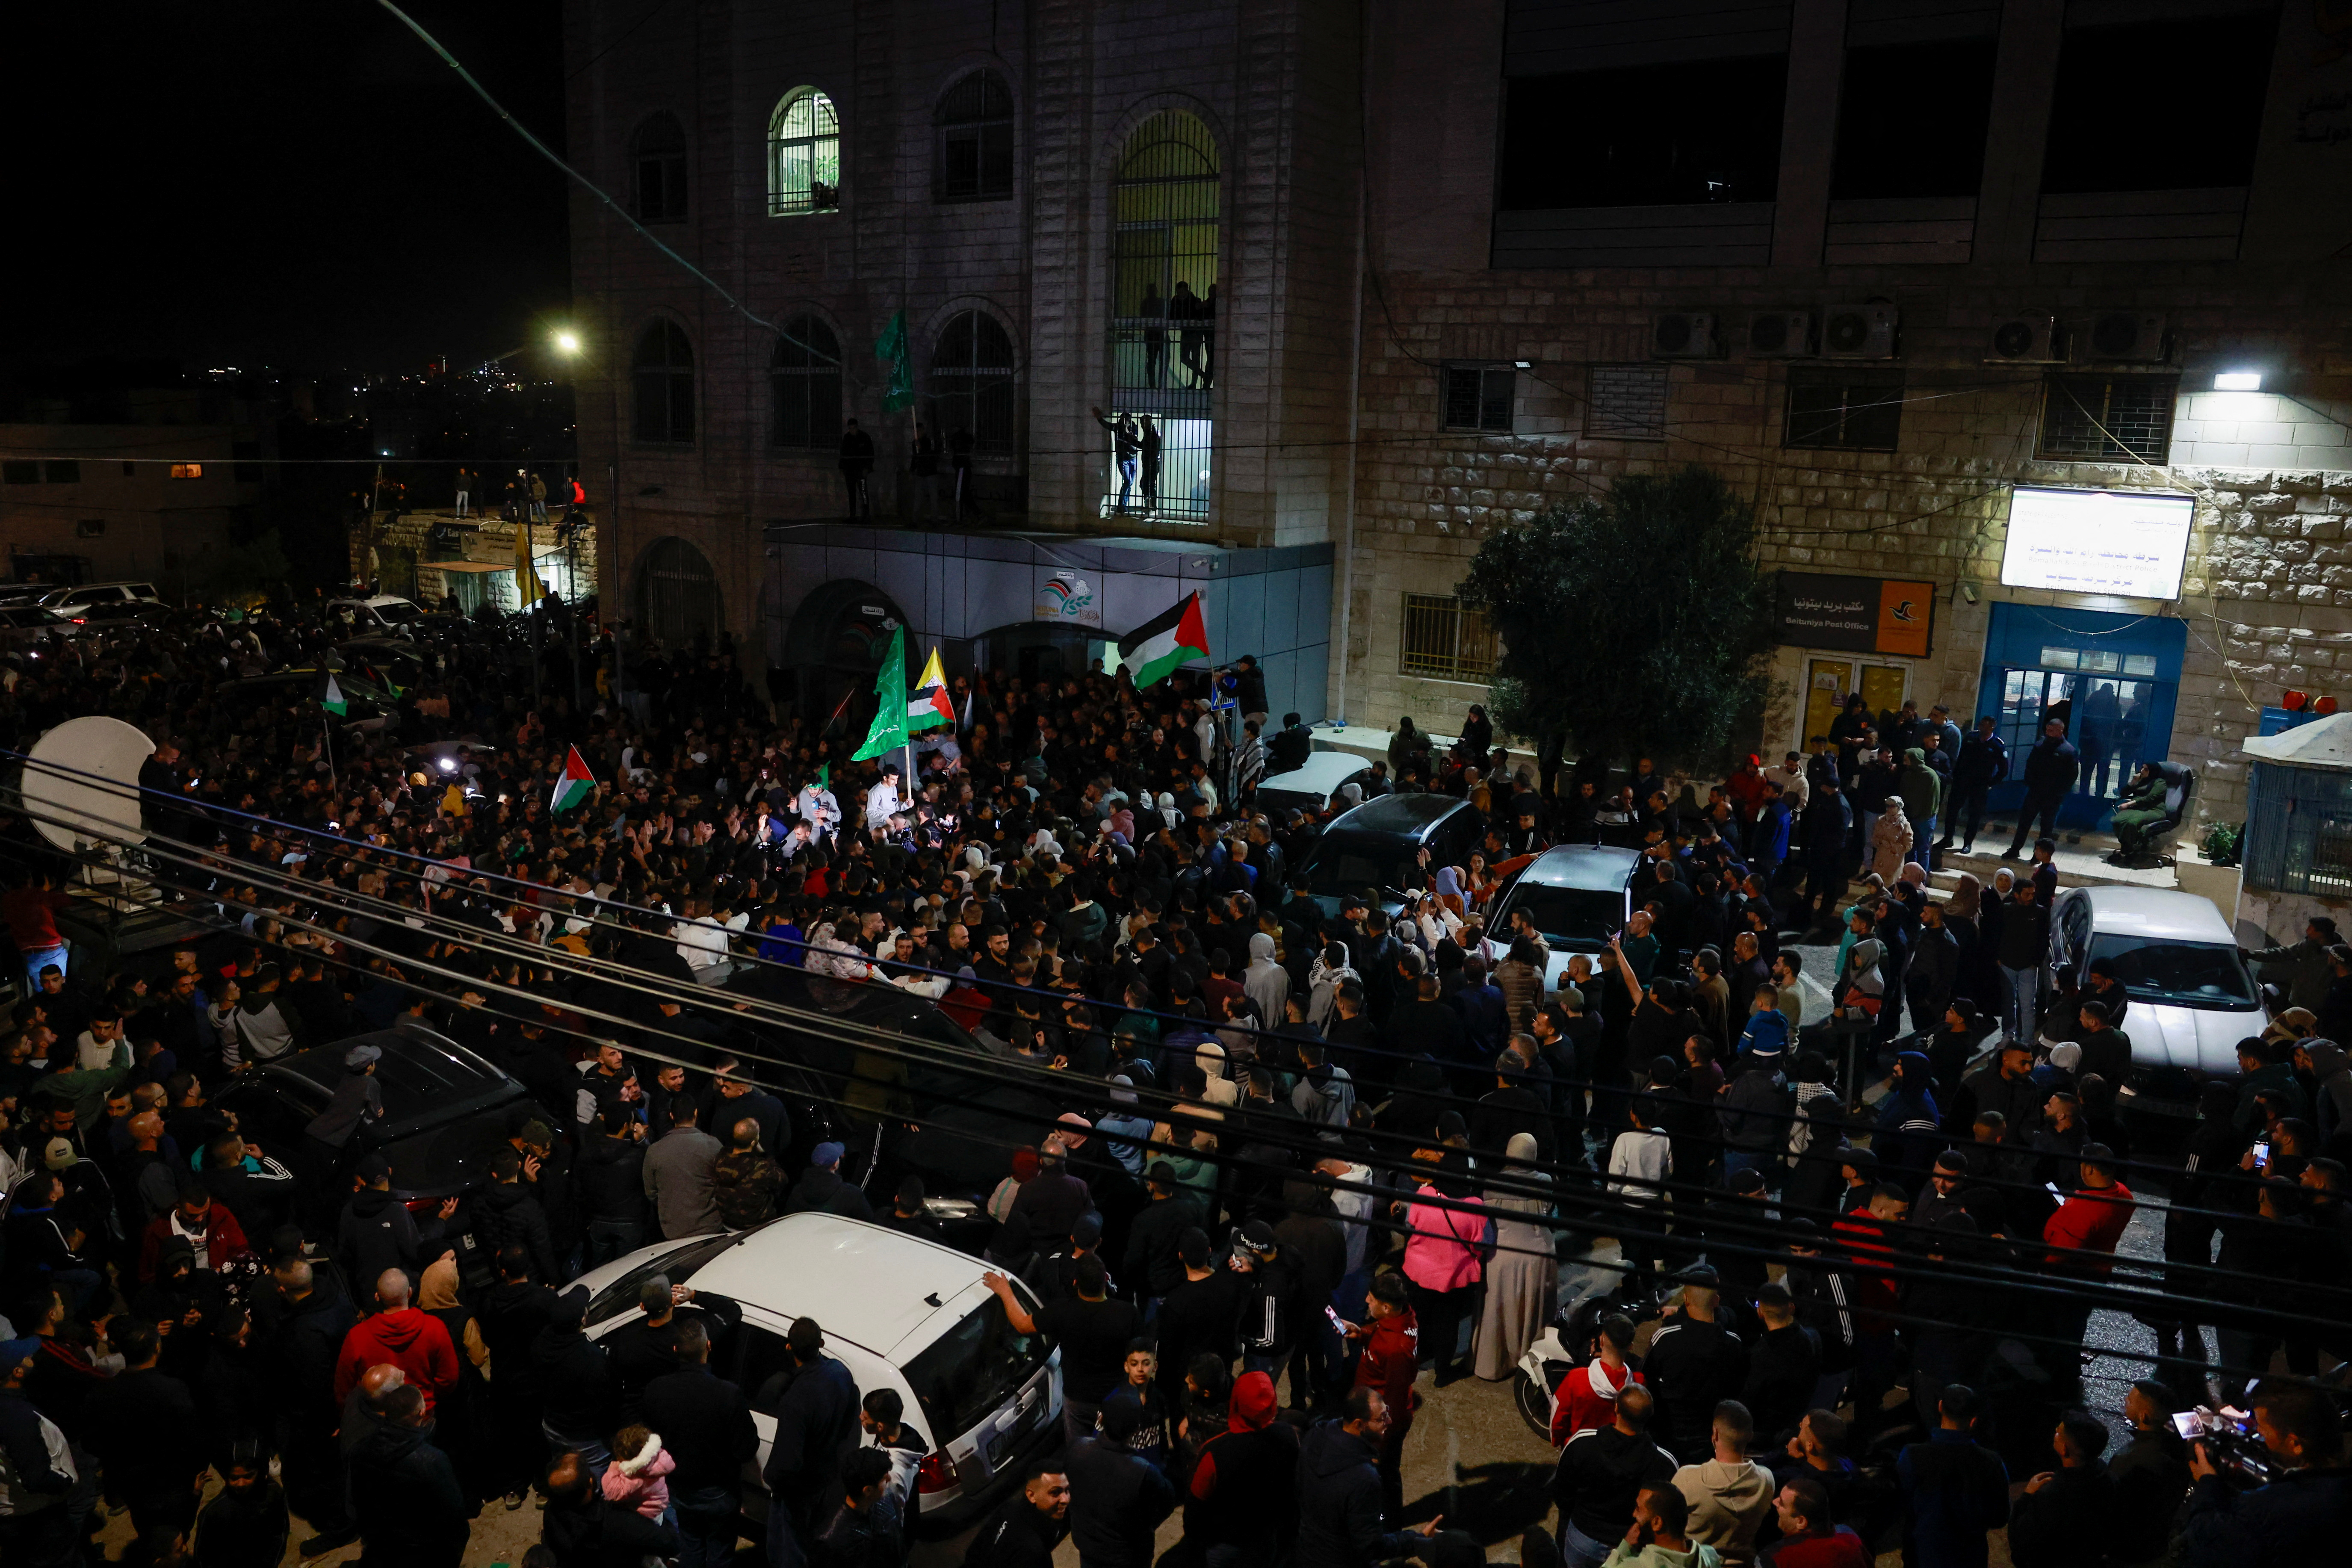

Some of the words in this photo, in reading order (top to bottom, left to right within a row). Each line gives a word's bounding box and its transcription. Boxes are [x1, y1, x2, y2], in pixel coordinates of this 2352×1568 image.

[2029, 556, 2063, 565] Ramallah
[2104, 562, 2133, 570] District
[2135, 564, 2158, 573] Police
[2110, 576, 2133, 587] مركز
[1794, 597, 1822, 611] بيتونيا
[1823, 600, 1842, 613] بريد
[1843, 601, 1865, 613] مكتب
[1786, 617, 1823, 627] Beituniya
[1825, 620, 1843, 628] Post
[1844, 622, 1870, 631] Office
